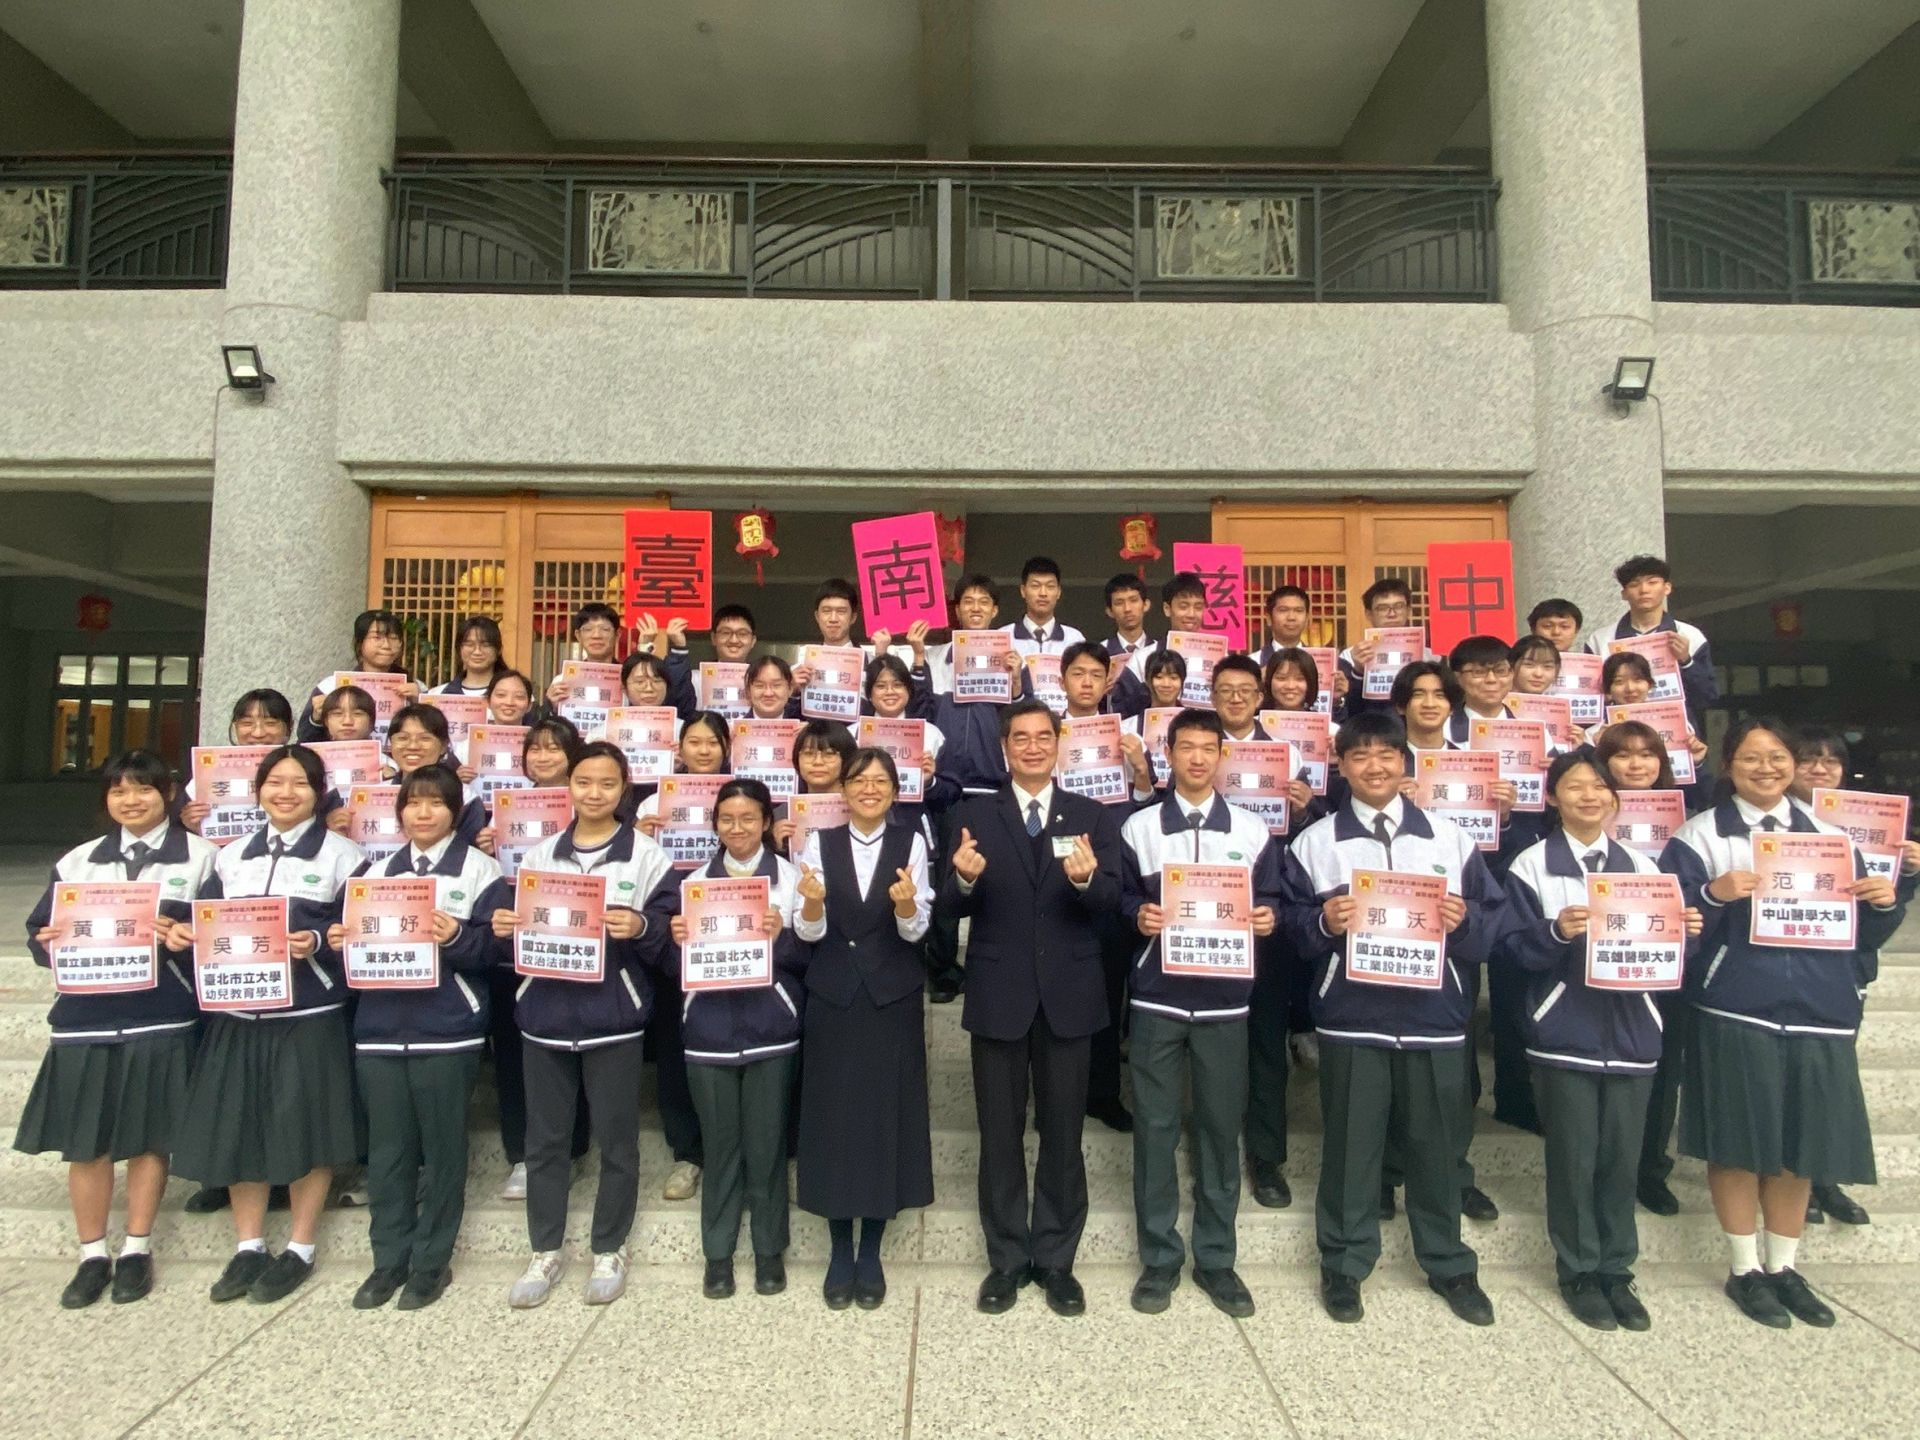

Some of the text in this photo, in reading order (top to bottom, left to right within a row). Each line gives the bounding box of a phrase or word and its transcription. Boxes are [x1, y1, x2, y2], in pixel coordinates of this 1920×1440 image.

[631, 534, 706, 609] 臺
[862, 540, 933, 617] 南
[1191, 563, 1241, 631] 慈
[1437, 563, 1505, 635] 中
[965, 655, 1001, 668] 林佑
[807, 691, 855, 704] 國立臺灣大學
[744, 746, 785, 761] 洪恩
[1064, 772, 1121, 788] 國立臺灣大學
[1226, 773, 1275, 788] 吳崴
[1432, 784, 1484, 801] 黃翔
[217, 810, 267, 822] 輔仁大學
[509, 821, 558, 838] 林頤
[1615, 825, 1669, 841] 黃雅
[1772, 872, 1836, 891] 范綺
[533, 907, 588, 928] 黃扉
[1180, 901, 1234, 919] 王映
[1762, 908, 1847, 922] 中山醫學大學
[361, 915, 419, 934] 劉妤
[700, 914, 754, 935] 郭真
[1367, 907, 1427, 930] 郭沃
[1607, 913, 1665, 932] 陳方
[72, 919, 137, 938] 黃甯
[1783, 924, 1825, 936] 醫學系
[213, 935, 270, 955] 吳芳
[522, 940, 595, 957] 國立高雄大學
[1170, 936, 1245, 950] 國立清華大學
[365, 951, 416, 964] 東海大學
[691, 948, 764, 964] 國立臺北大學
[1170, 951, 1245, 965] 電機工程學系
[1356, 942, 1436, 961] 國立成功大學
[1597, 950, 1676, 963] 高雄醫學大學
[57, 955, 150, 968] 國立臺灣海洋大學
[522, 954, 595, 971] 政治法律學系
[1356, 958, 1435, 977] 工業設計學系
[204, 971, 282, 986] 臺北市立大學
[703, 964, 751, 979] 歷史學系
[1618, 966, 1656, 979] 醫學系
[205, 985, 282, 1000] 幼兒教育學系
